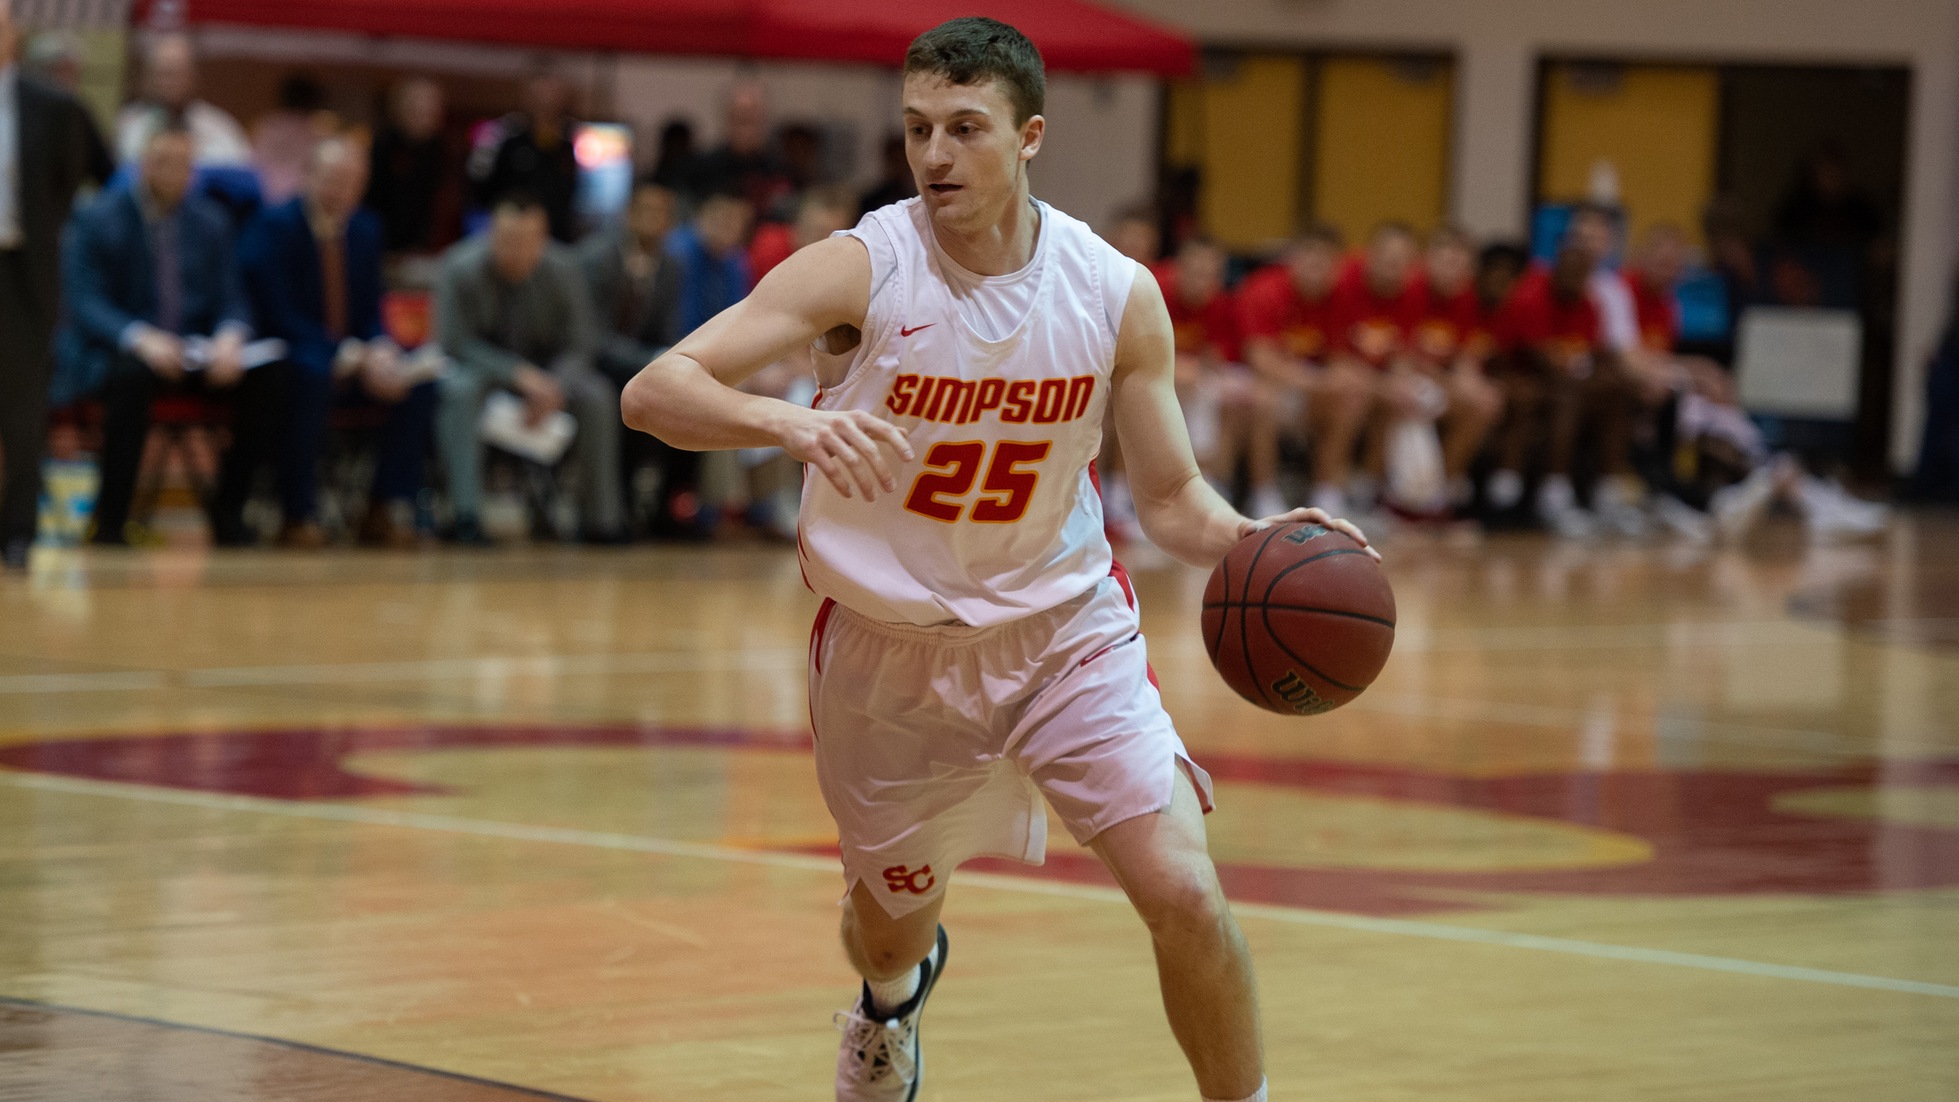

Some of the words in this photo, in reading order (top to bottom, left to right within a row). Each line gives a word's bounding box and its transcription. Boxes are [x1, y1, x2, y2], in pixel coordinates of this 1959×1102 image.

[884, 373, 1096, 426] SIMPSON
[902, 439, 1053, 524] 25
[882, 864, 935, 896] SC
